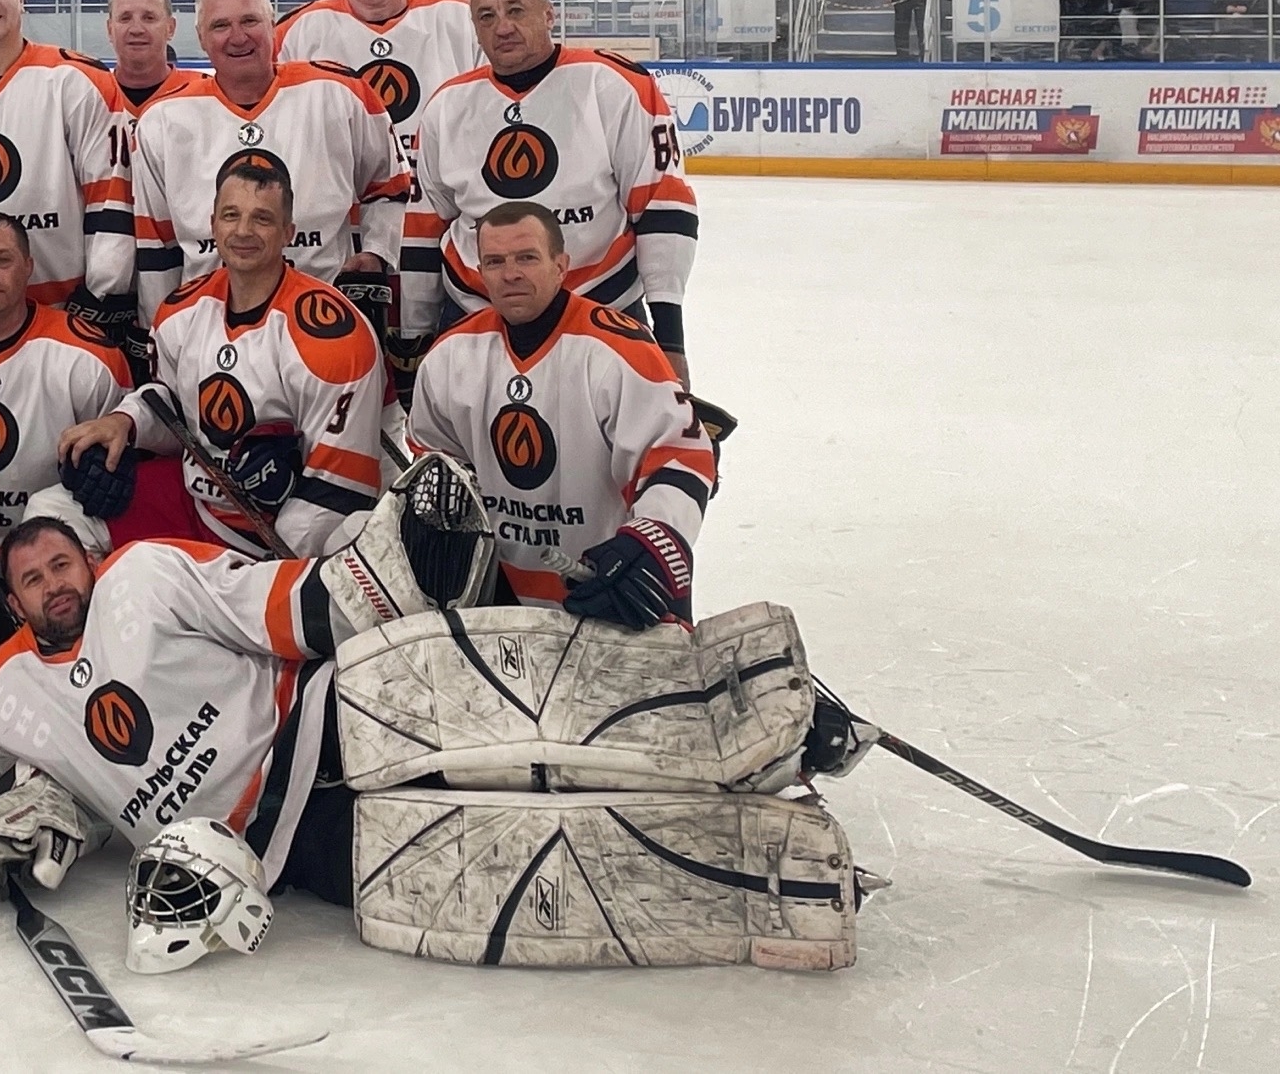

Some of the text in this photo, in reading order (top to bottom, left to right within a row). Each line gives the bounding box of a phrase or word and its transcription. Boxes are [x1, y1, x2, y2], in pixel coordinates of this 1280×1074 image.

[734, 26, 774, 34] СЕКТОР
[1014, 25, 1058, 33] СЕКТОР
[951, 88, 1038, 106] КРАСНАЯ
[1148, 87, 1240, 105] КРАСНАЯ
[713, 96, 861, 134] БУРЭНЕРГО
[947, 110, 1038, 131] МАШИНА
[1145, 109, 1241, 130] МАШИНА
[484, 494, 585, 525] РАЛЬСЯ
[344, 557, 394, 623] ARRIOR
[120, 701, 221, 828] УРАЛЬСКАЯ
[155, 747, 219, 826] СТАЛЬ
[33, 938, 135, 1028] CCM
